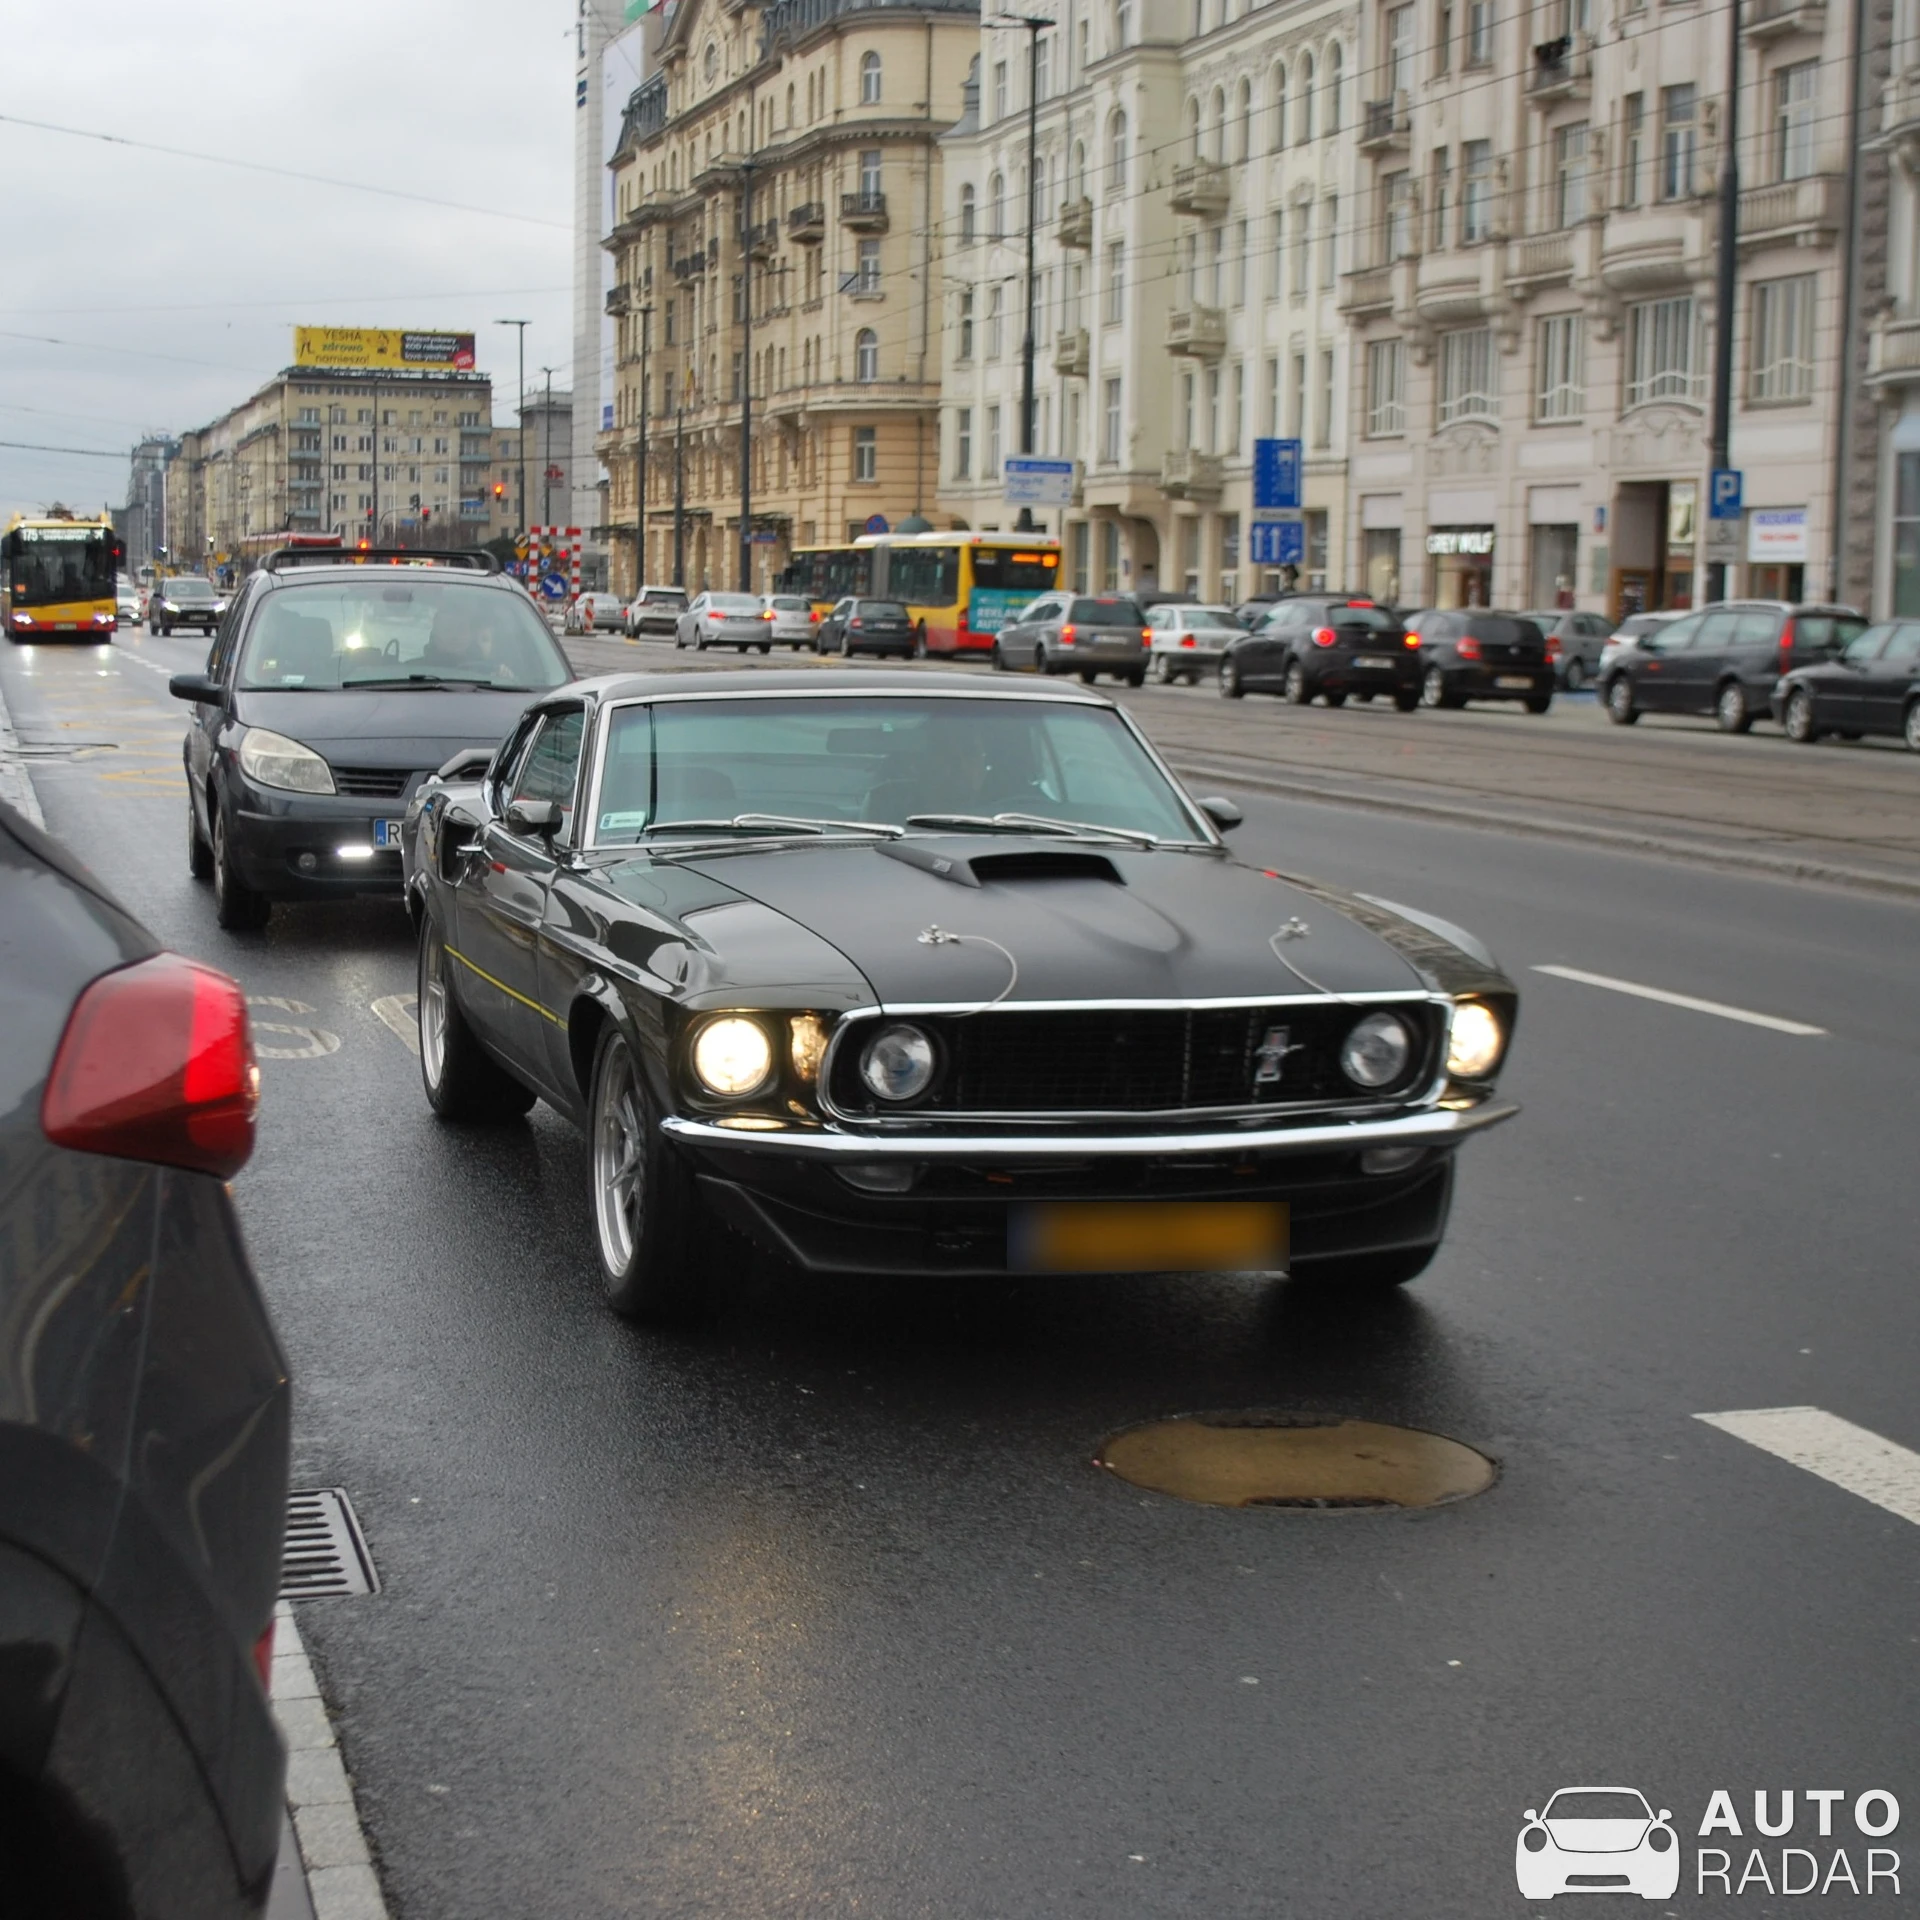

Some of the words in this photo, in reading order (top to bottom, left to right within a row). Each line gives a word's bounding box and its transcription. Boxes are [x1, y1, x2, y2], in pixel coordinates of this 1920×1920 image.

[323, 331, 362, 341] YESHA
[322, 343, 363, 352] zdrowo
[1715, 475, 1737, 505] P
[22, 529, 39, 541] 175
[1427, 534, 1457, 554] GREY
[1459, 531, 1493, 554] WOLF
[976, 619, 1003, 629] AUTO
[387, 823, 405, 843] R
